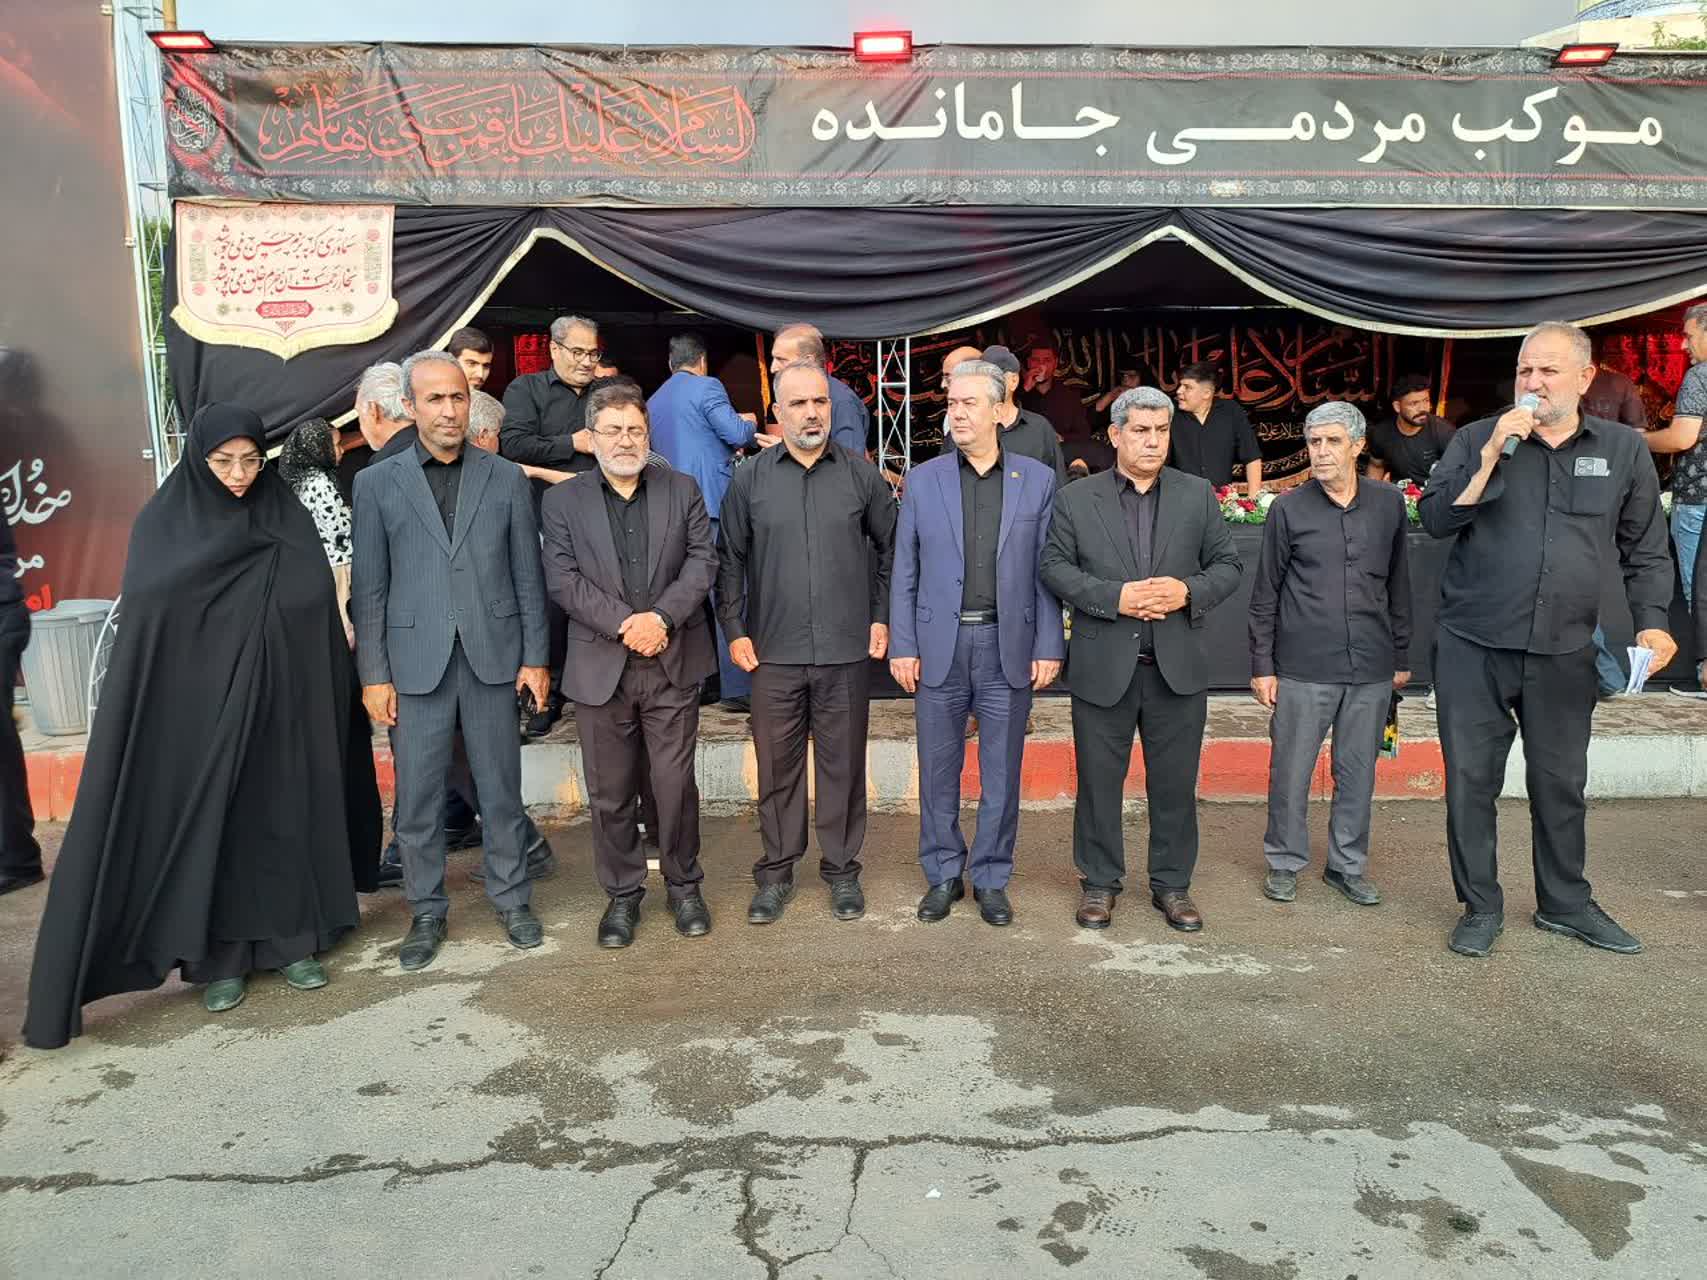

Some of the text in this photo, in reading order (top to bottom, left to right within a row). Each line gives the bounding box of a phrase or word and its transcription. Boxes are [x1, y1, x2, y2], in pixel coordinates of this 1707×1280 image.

[811, 81, 1663, 165] موکب مردمی جامانده
